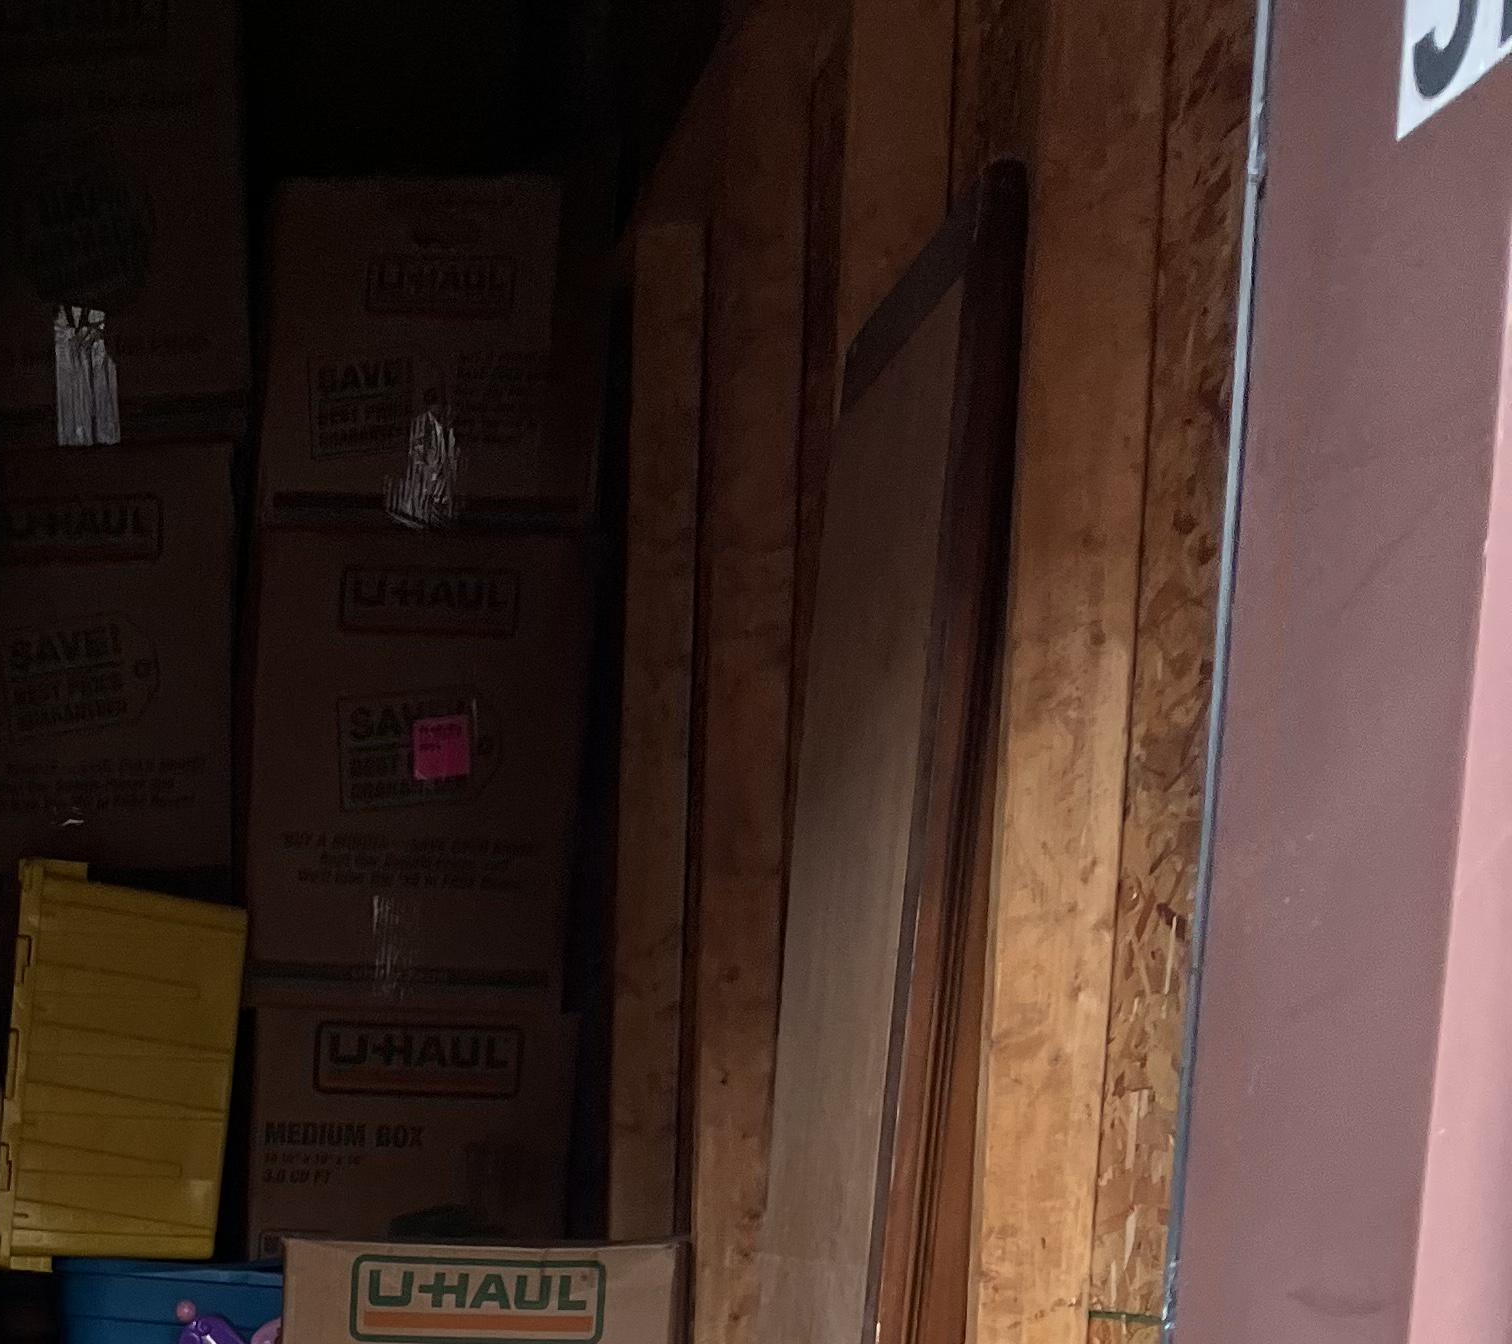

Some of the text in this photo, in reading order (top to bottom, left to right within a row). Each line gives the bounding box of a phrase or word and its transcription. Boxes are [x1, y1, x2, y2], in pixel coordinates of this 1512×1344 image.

[329, 1033, 509, 1069] U-HAUL
[264, 1121, 425, 1149] MEDIUM BOX
[368, 1269, 588, 1312] U-HAUL
